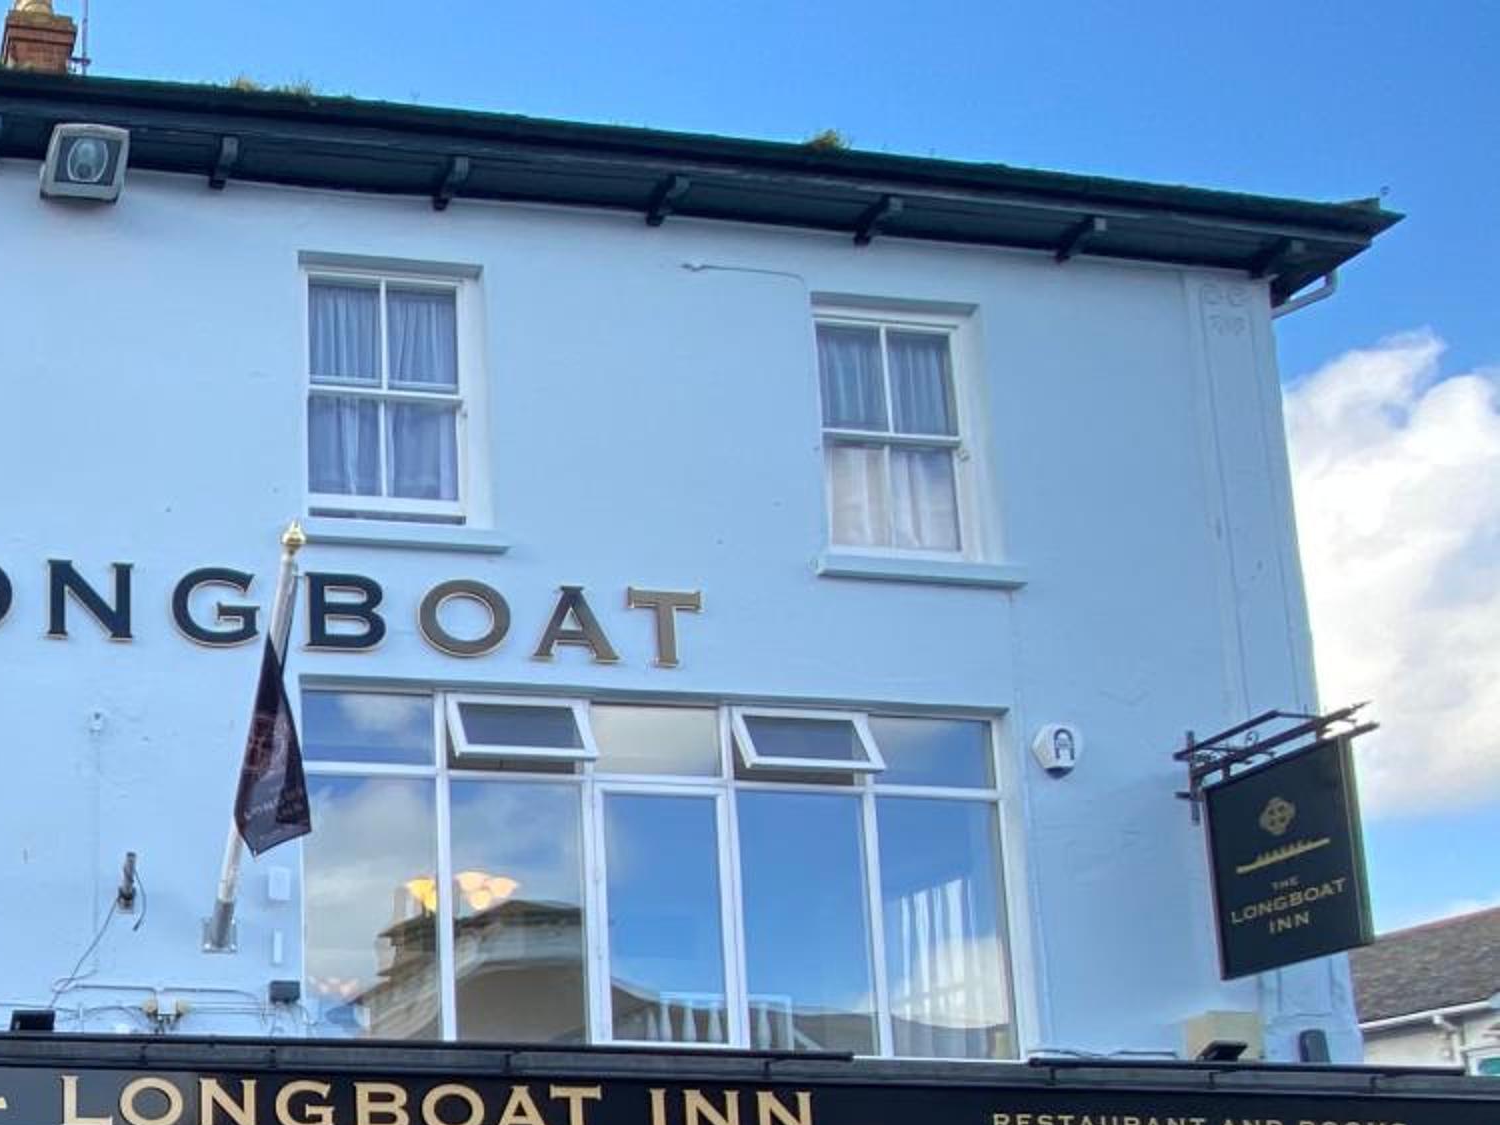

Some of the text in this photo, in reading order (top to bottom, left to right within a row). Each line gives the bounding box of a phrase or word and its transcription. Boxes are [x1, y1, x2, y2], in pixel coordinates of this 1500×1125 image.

[1271, 876, 1299, 890] THE
[1231, 877, 1348, 925] LONGBOAT
[1269, 911, 1310, 934] INN
